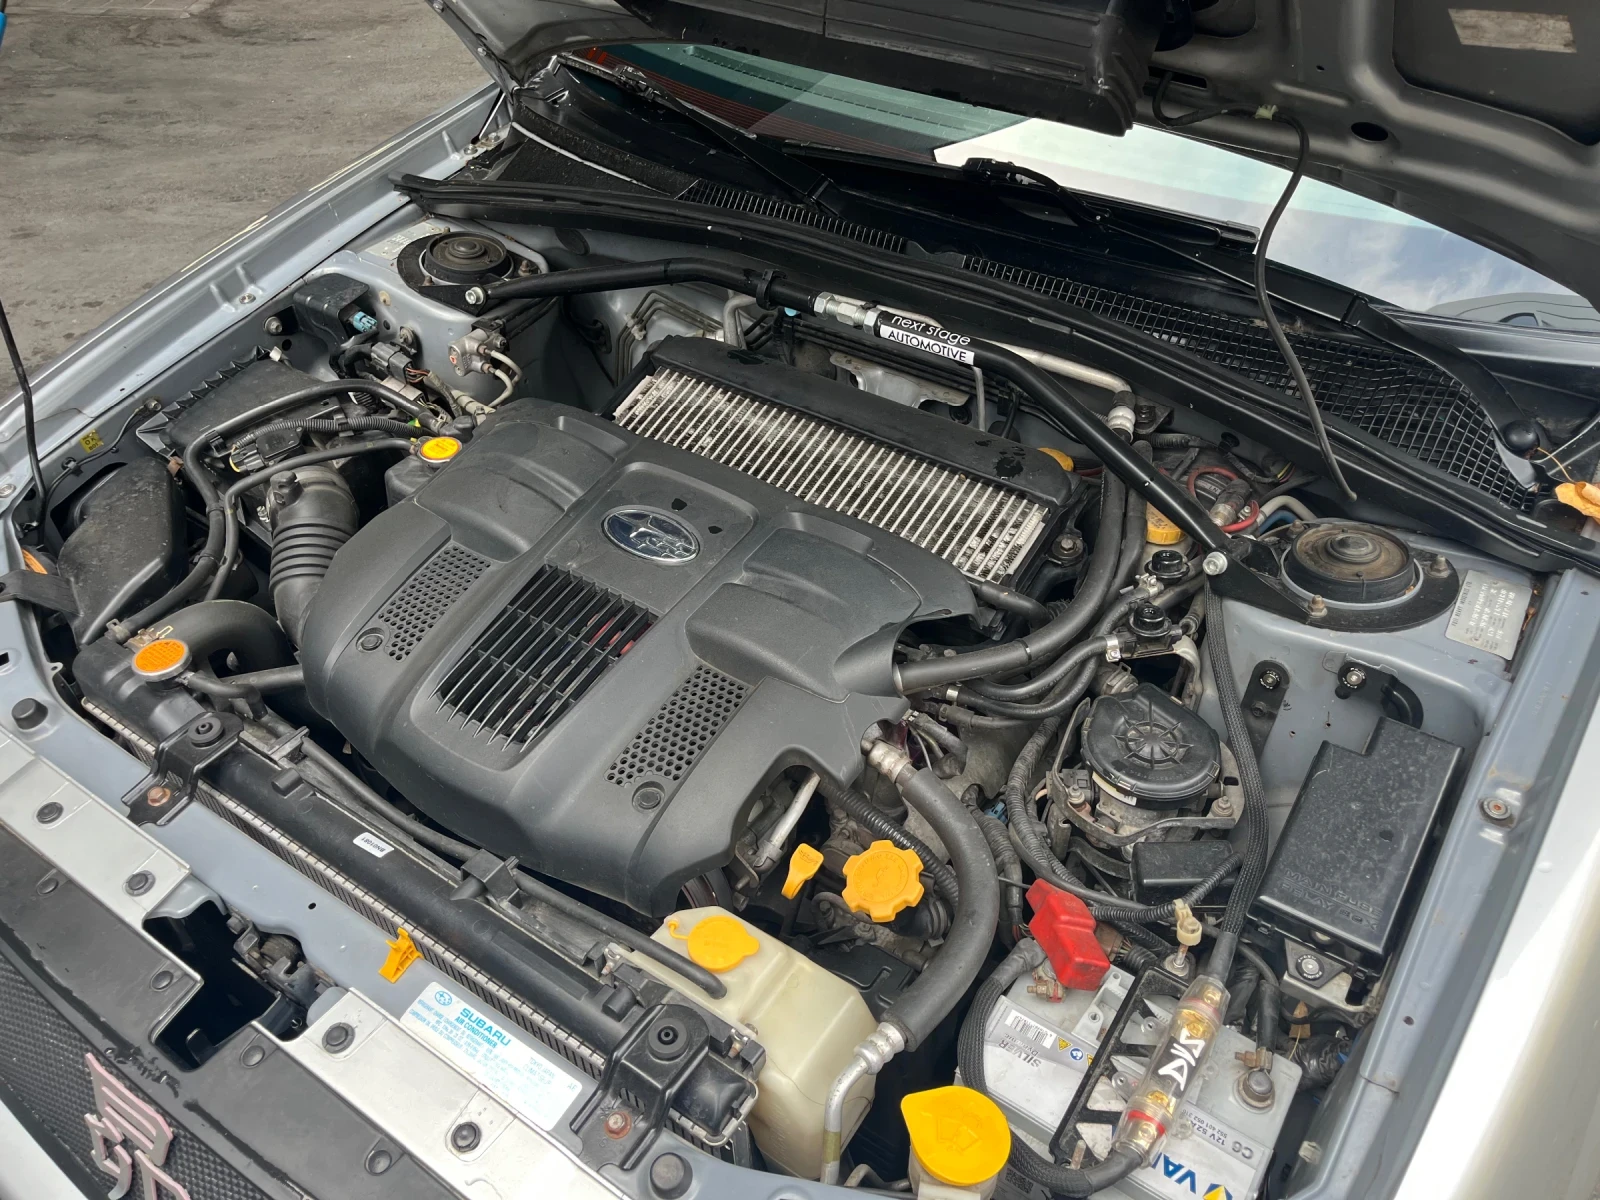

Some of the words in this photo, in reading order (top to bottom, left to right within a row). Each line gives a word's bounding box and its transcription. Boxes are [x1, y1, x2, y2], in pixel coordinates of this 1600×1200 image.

[888, 329, 967, 362] AUTOMOTIVE
[891, 314, 926, 332] next
[926, 324, 971, 346] stage
[454, 1016, 464, 1027] AIR
[463, 1022, 498, 1049] CONDITIONER
[460, 1007, 511, 1047] SUBARU
[998, 1040, 1042, 1067] SILVER
[1231, 1141, 1254, 1160] C6
